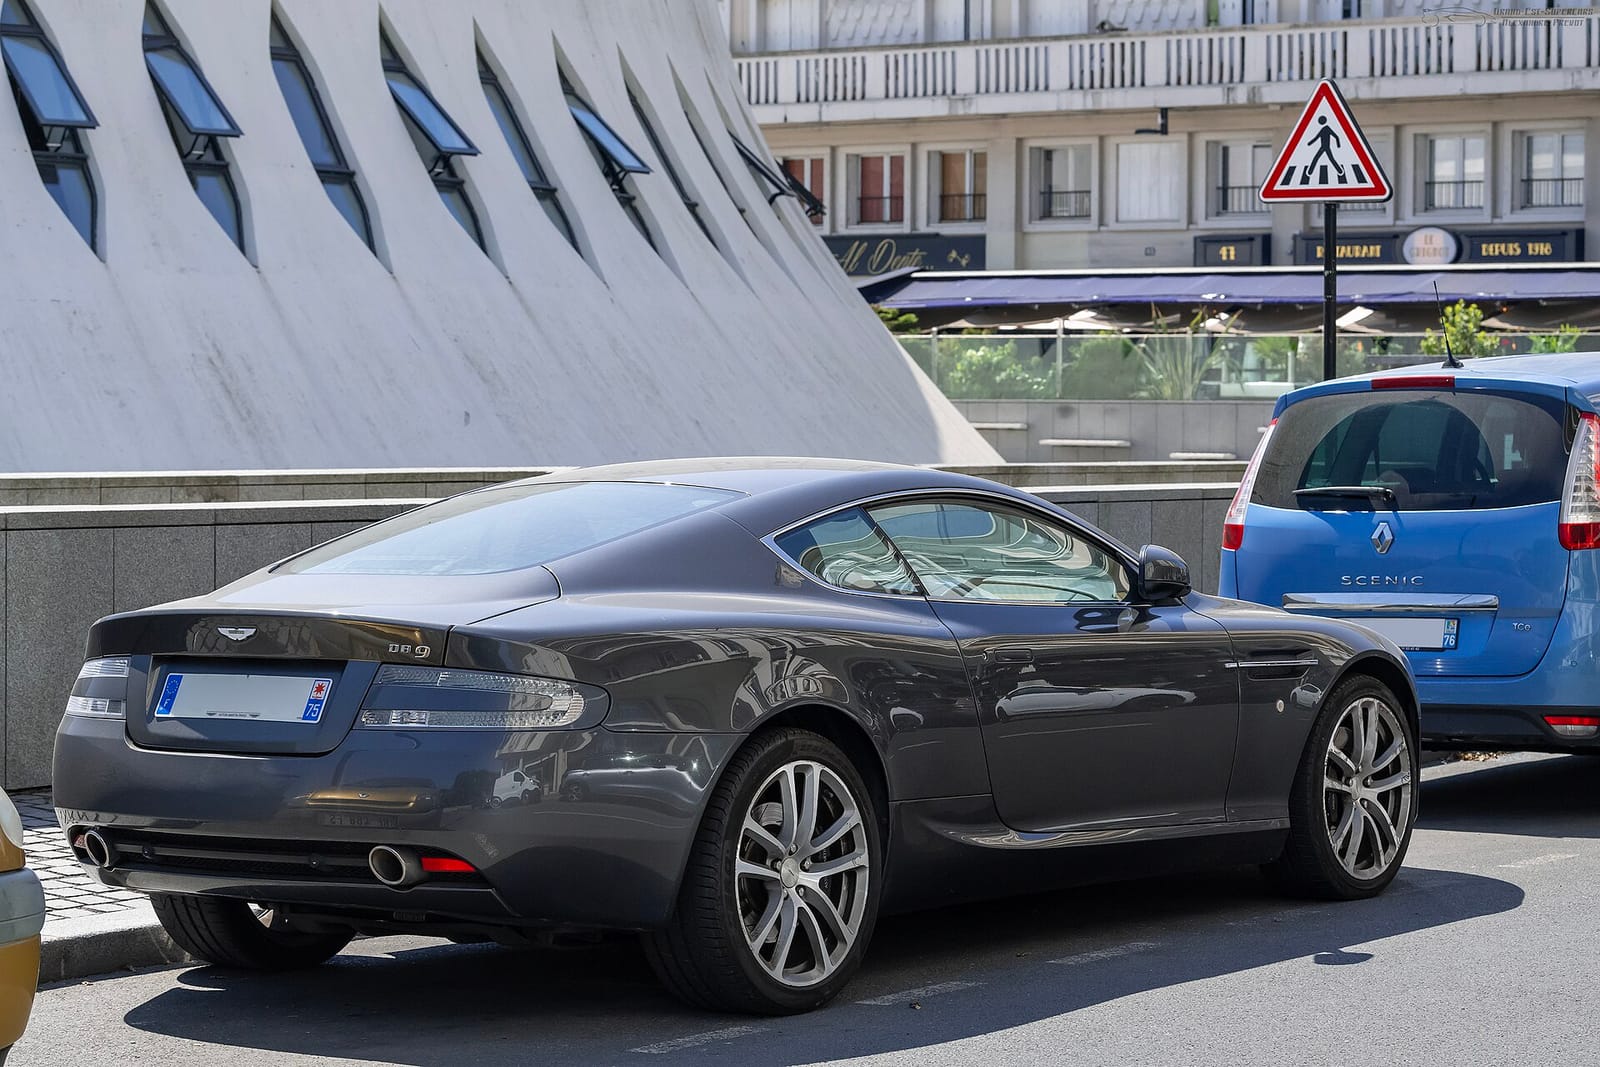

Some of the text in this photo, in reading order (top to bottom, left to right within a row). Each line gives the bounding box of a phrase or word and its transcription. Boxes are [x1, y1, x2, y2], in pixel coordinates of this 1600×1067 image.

[835, 239, 868, 273] Al
[1481, 243, 1522, 257] DEPUIS
[1341, 575, 1425, 586] SCENIC
[1443, 634, 1456, 647] 76
[305, 703, 321, 718] 75
